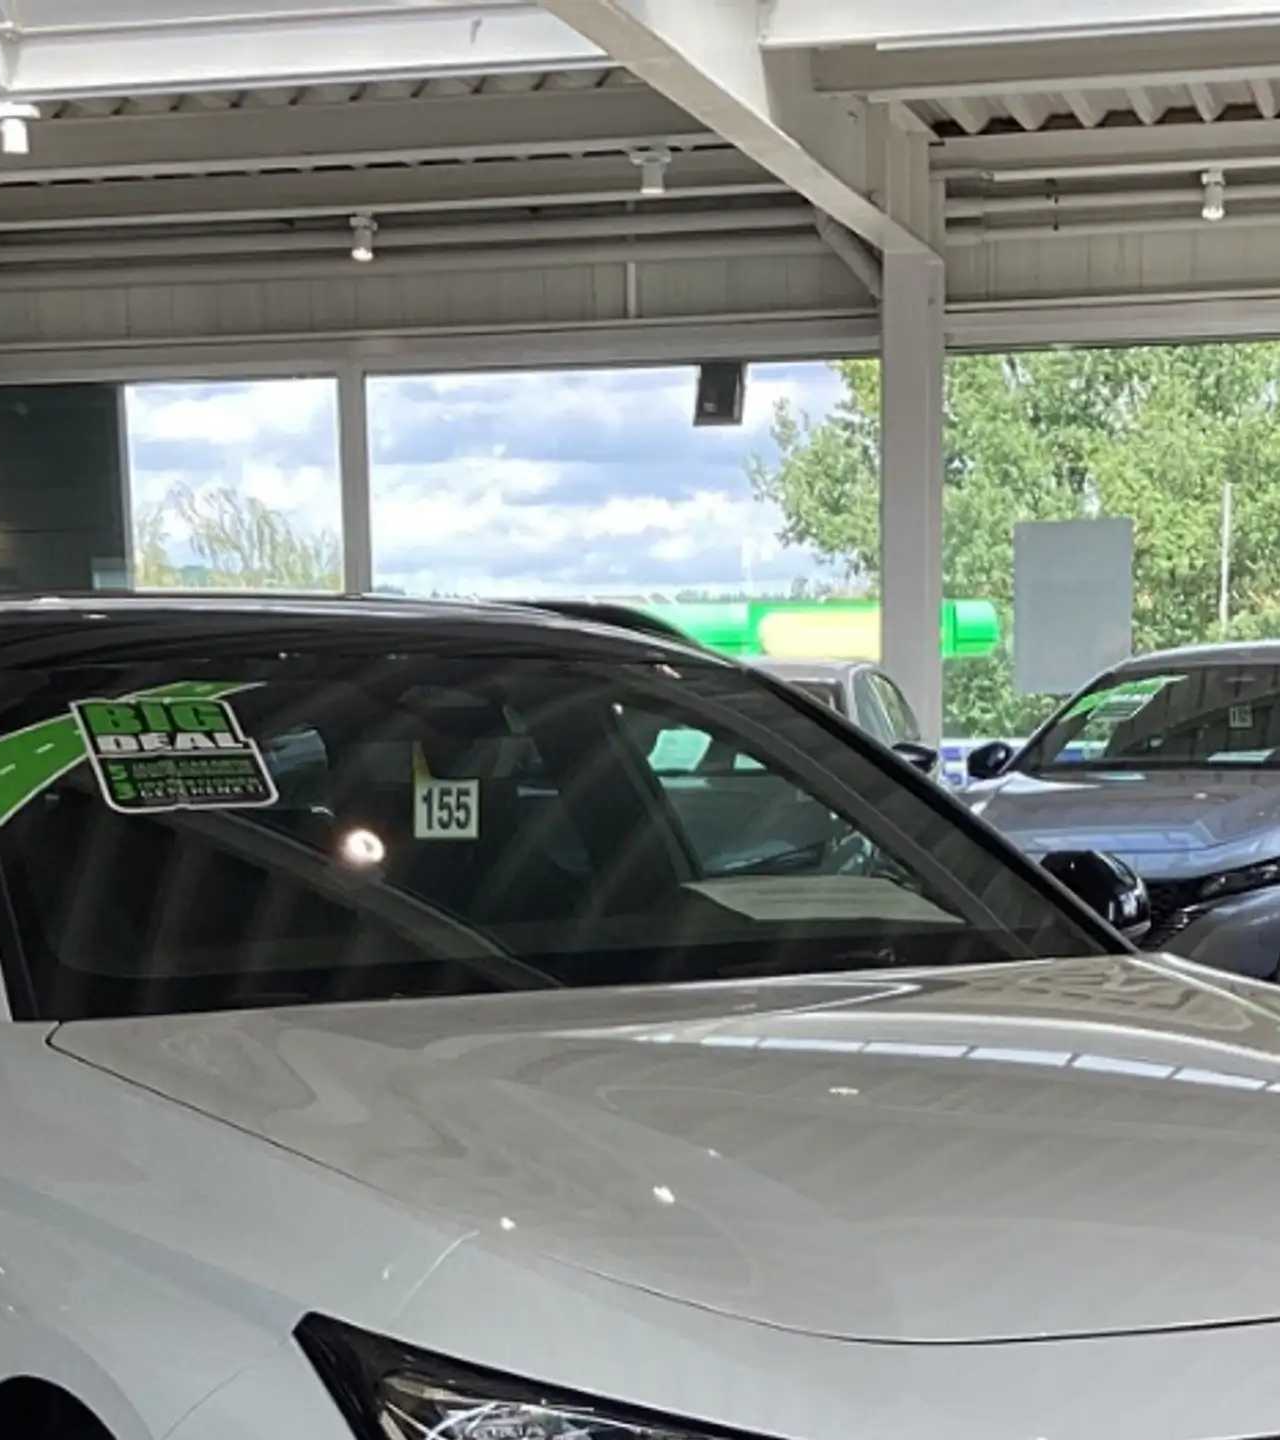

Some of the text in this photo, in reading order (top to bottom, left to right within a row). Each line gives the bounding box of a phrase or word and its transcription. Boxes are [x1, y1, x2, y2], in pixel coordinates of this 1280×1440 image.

[85, 702, 230, 734] BIG
[96, 731, 244, 751] DEAL
[422, 787, 472, 831] 155
